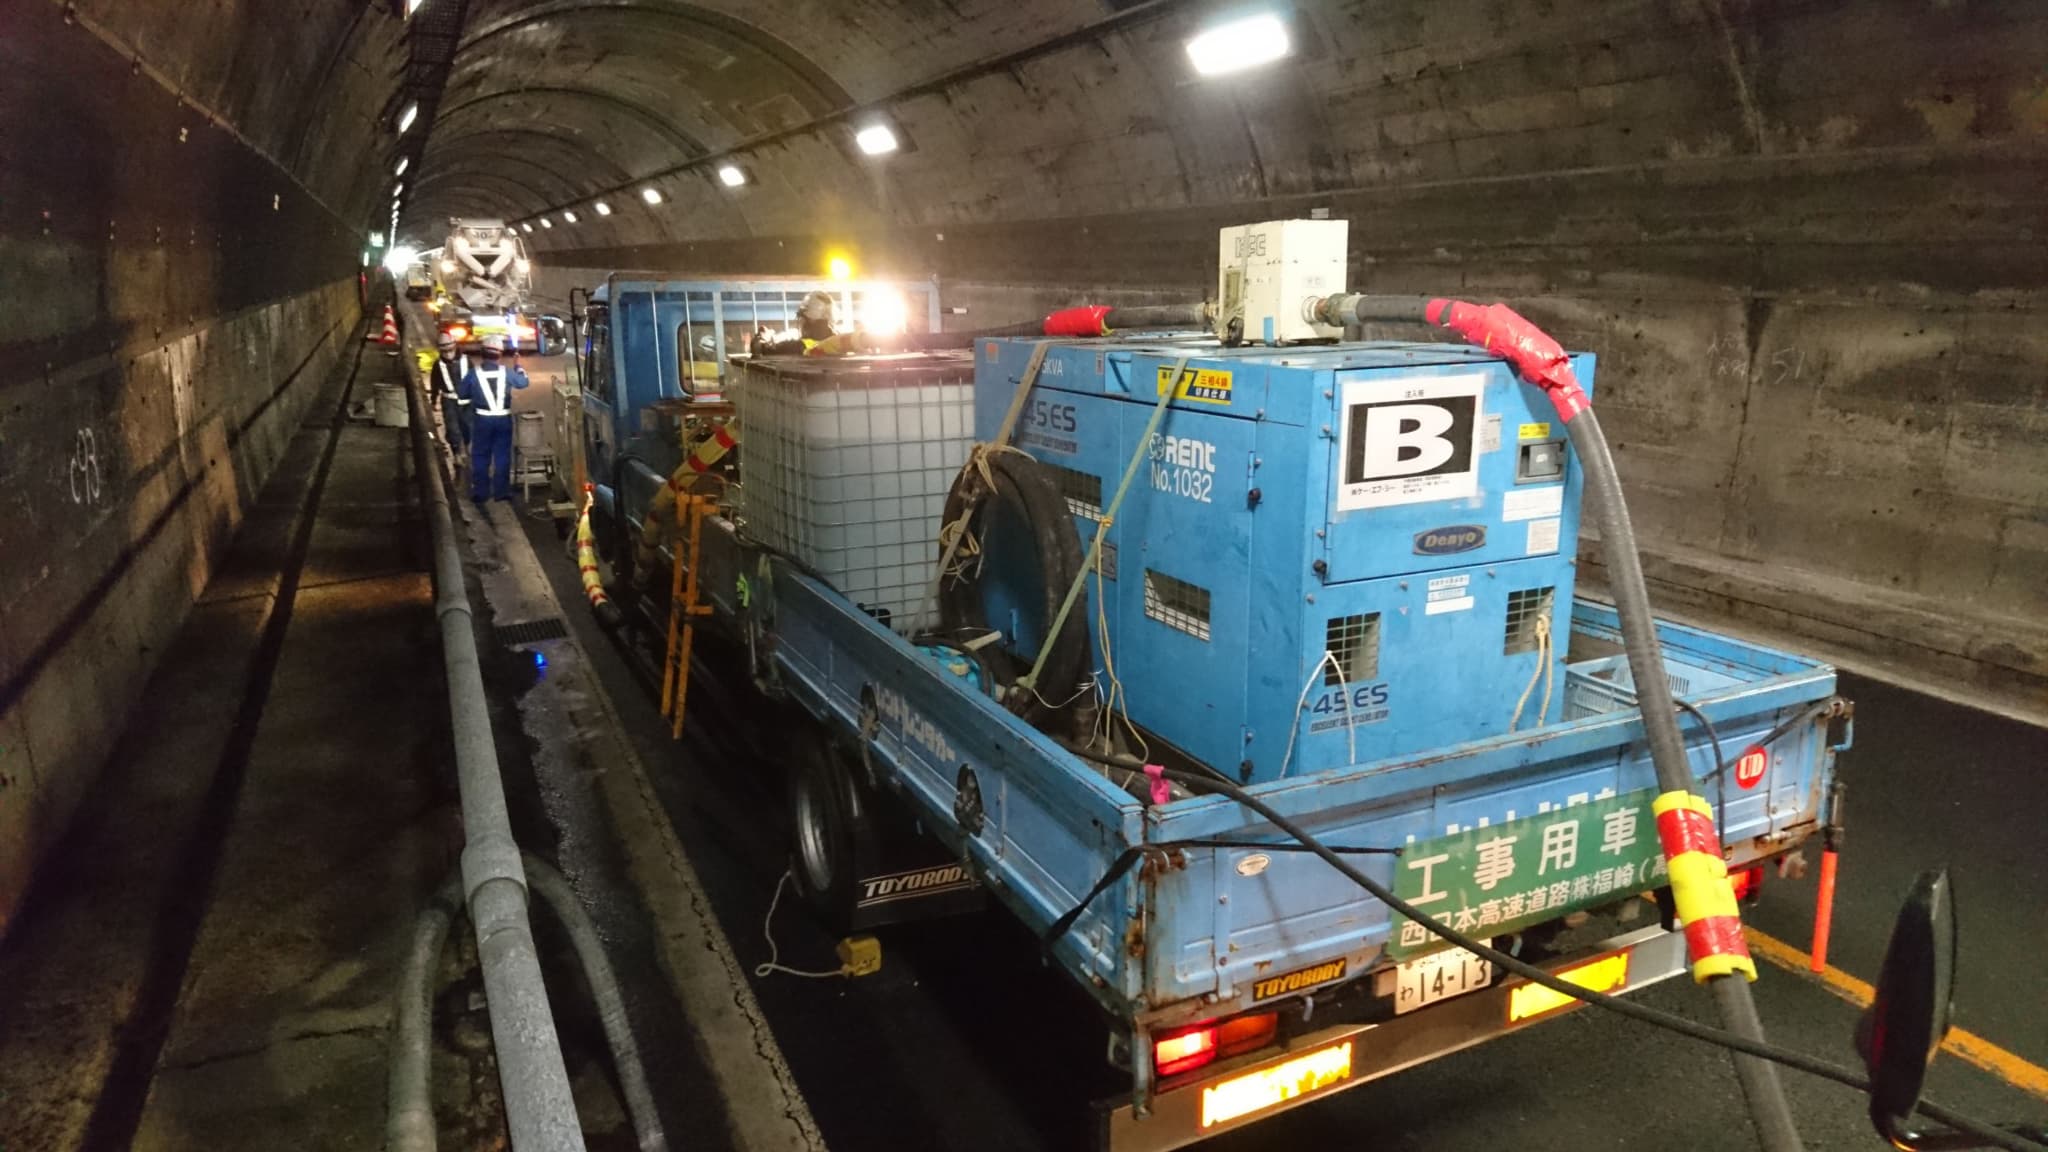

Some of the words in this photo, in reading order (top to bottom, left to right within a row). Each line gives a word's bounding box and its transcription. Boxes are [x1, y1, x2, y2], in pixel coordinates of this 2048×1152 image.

[1363, 404, 1454, 480] B
[1151, 461, 1212, 503] No.1032
[1424, 531, 1477, 548] Denyo
[1739, 753, 1764, 780] UD
[1403, 807, 1662, 906] 工事用車
[1255, 960, 1345, 999] TOYOBODY
